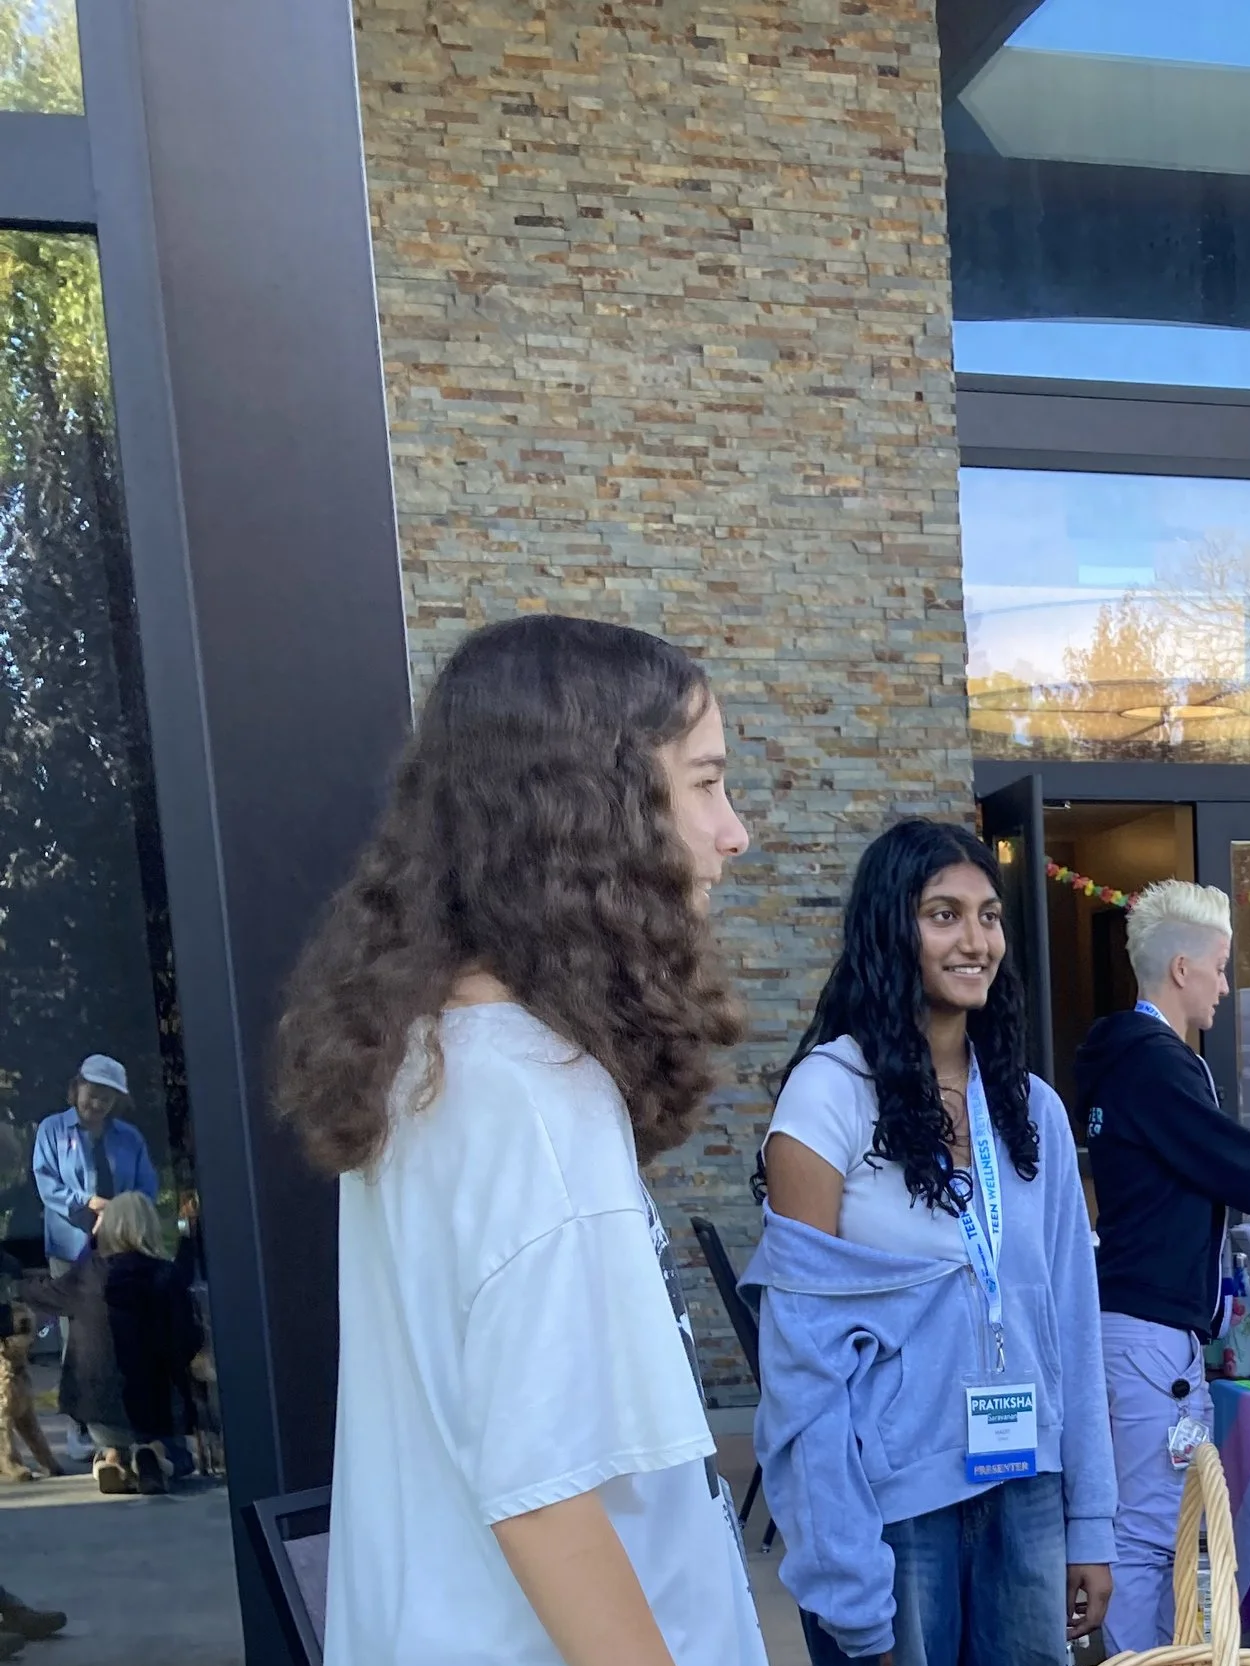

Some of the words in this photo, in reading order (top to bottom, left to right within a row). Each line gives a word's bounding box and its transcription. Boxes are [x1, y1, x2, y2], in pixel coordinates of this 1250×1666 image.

[978, 1139, 995, 1200] WELLNESS
[990, 1204, 999, 1234] TEEN
[972, 1396, 1032, 1411] PRATIKSHA
[974, 1461, 1029, 1476] PRESENTER
